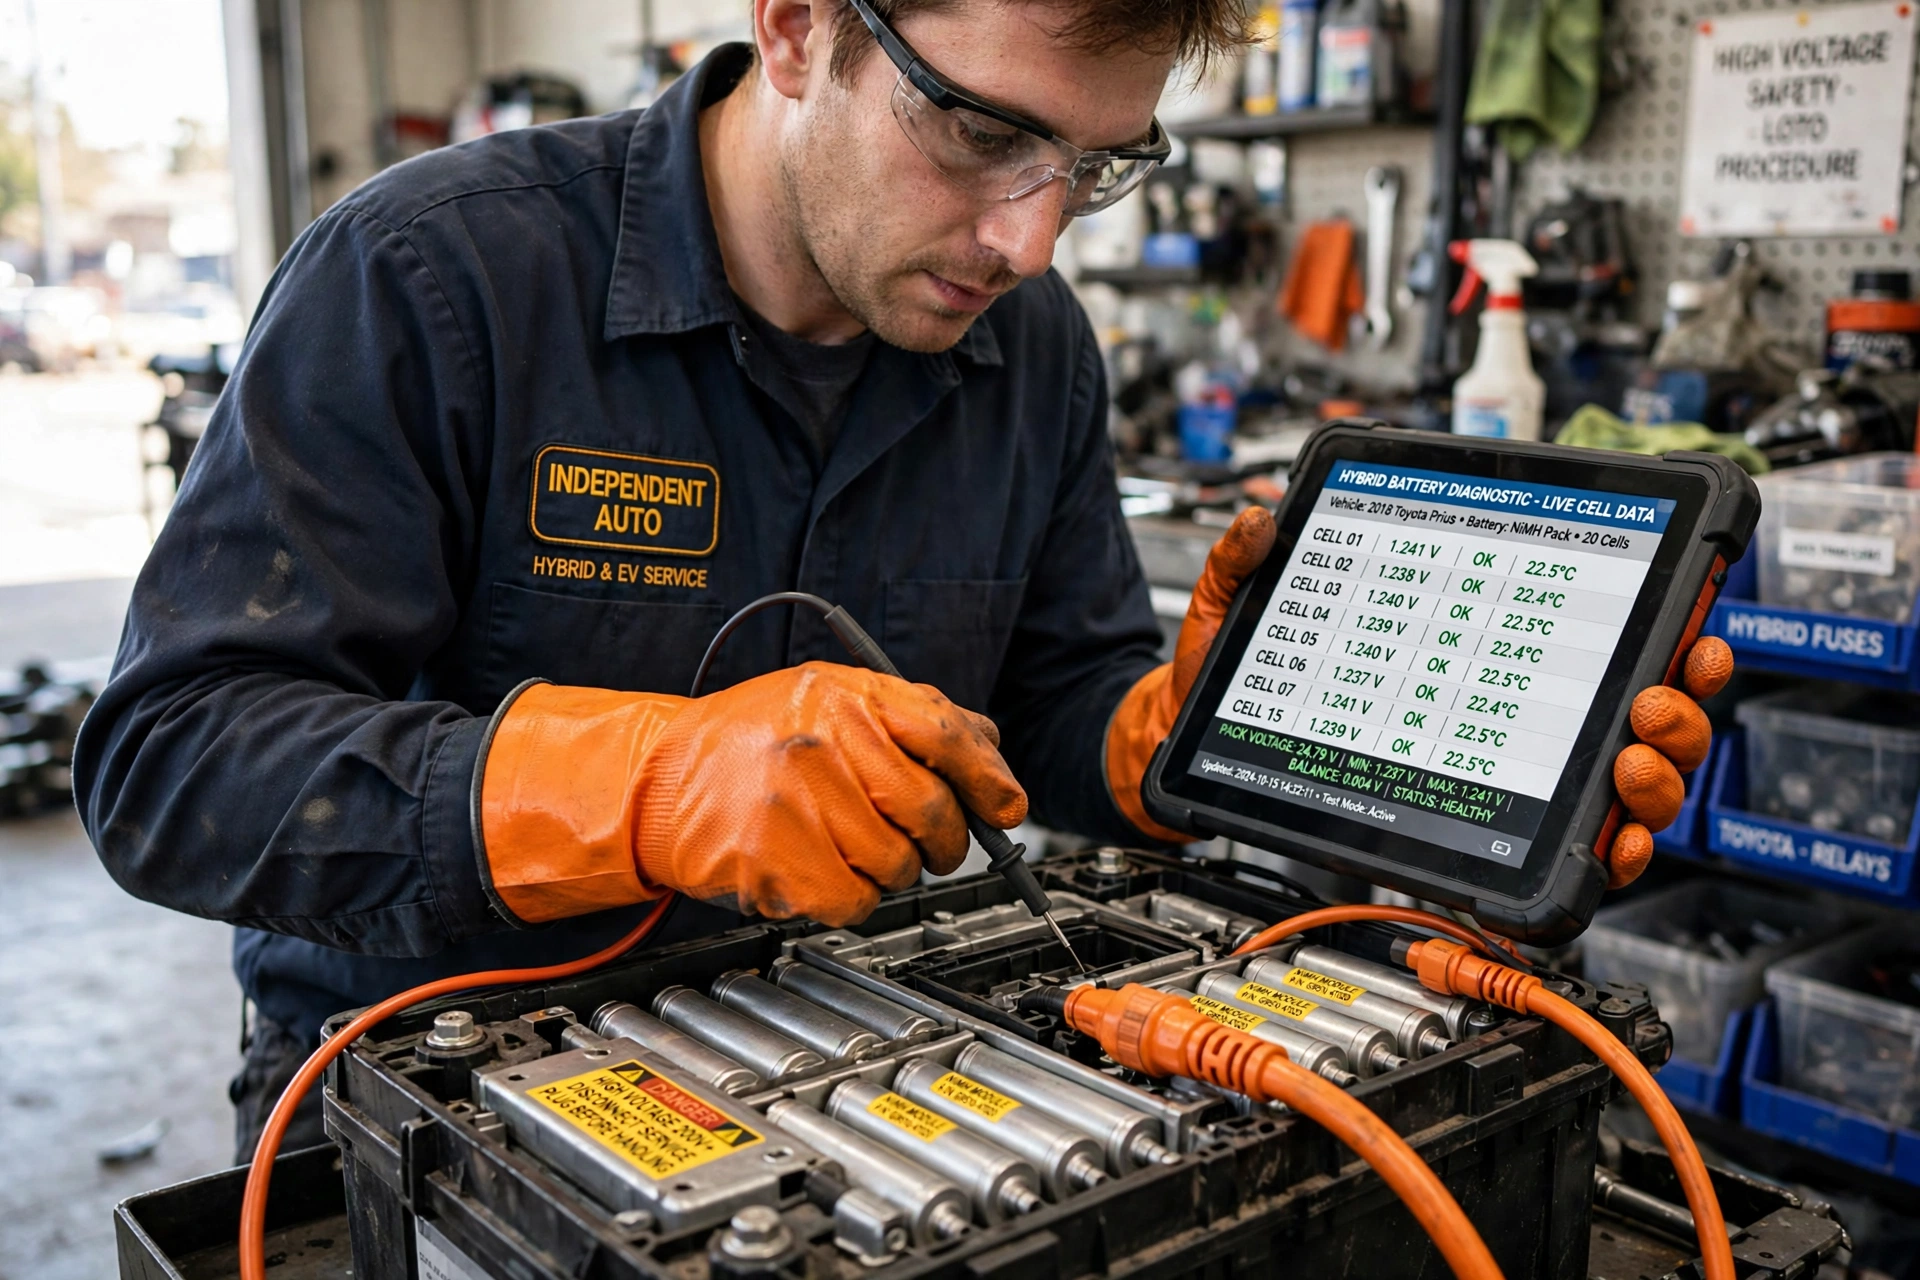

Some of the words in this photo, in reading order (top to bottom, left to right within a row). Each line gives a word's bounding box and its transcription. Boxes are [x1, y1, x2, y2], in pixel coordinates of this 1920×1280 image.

[1713, 42, 1773, 72] HIGH
[1779, 32, 1890, 70] VOLTAGE
[1748, 74, 1839, 108] SAFETY
[1762, 112, 1829, 145] LOTO
[1714, 149, 1861, 183] PROCEDURE
[549, 463, 707, 507] INDEPENDENT
[1338, 469, 1387, 488] HYBRID
[1387, 475, 1448, 495] BATTERY
[1447, 483, 1532, 506] DIAGNOSTIC
[1542, 495, 1576, 512] LIVE
[1576, 500, 1612, 517] CELL
[1615, 504, 1655, 523] DATA
[594, 504, 662, 536] AUTO
[1330, 496, 1367, 512] Vehicle:
[1367, 501, 1394, 515] 2018
[1395, 505, 1427, 521] Toyota
[1429, 510, 1456, 525] Prius
[1466, 516, 1507, 534] Battery:
[1510, 521, 1543, 538] NiMH
[1543, 525, 1572, 541] Pack
[1582, 531, 1599, 545] 20
[1600, 534, 1630, 549] Cells
[533, 556, 596, 580] HYBRID
[600, 562, 612, 581] &
[618, 564, 639, 583] EV
[643, 566, 708, 588] SERVICE
[1301, 551, 1330, 568] CELL
[1334, 557, 1353, 572] 02
[1378, 564, 1416, 583] 1.238
[1419, 570, 1430, 584] V
[1461, 578, 1485, 595] OK
[1513, 587, 1565, 608] 22.4°C
[1313, 527, 1342, 544] CELL
[1346, 532, 1363, 547] 01
[1390, 539, 1426, 557] 1.241
[1430, 545, 1442, 559] V
[1472, 551, 1497, 568] OK
[1525, 560, 1577, 581] 22.5°C
[1278, 600, 1308, 618] CELL
[1312, 606, 1331, 622] 04
[1356, 614, 1393, 633] 1.239
[1396, 621, 1408, 636] V
[1438, 630, 1462, 647] OK
[1490, 640, 1543, 663] 22.4°C
[1290, 575, 1320, 593] CELL
[1323, 581, 1342, 596] 03
[1367, 589, 1404, 608] 1.240
[1408, 595, 1419, 610] V
[1450, 604, 1474, 621] OK
[1502, 613, 1554, 636] 22.5°C
[1267, 624, 1296, 643] CELL
[1300, 631, 1319, 646] 05
[1344, 640, 1382, 660] 1.240
[1385, 649, 1396, 662] V
[1427, 657, 1451, 674] OK
[1478, 668, 1531, 691] 22.5°C
[1727, 611, 1808, 646] HYBRID
[1811, 623, 1884, 658] FUSES
[1244, 674, 1274, 693] CELL
[1277, 681, 1297, 697] 07
[1321, 692, 1357, 712] 1.241
[1361, 700, 1373, 715] V
[1403, 711, 1427, 729] OK
[1454, 723, 1507, 747] 22.5°C
[1255, 649, 1285, 668] CELL
[1289, 656, 1307, 672] 06
[1333, 666, 1372, 686] 1.237
[1374, 674, 1385, 689] V
[1415, 684, 1439, 702] OK
[1466, 695, 1519, 719] 22.4°C
[1218, 723, 1248, 741] PACK
[1249, 730, 1297, 753] VOLTAGE:
[1296, 743, 1327, 760] 24.79
[1329, 750, 1339, 763] V
[1347, 755, 1373, 773] MIN:
[1374, 763, 1406, 781] 1.237
[1407, 770, 1417, 783] V
[1426, 776, 1458, 795] MAX:
[1461, 785, 1492, 804] 1.241
[1495, 793, 1506, 806] V
[1232, 699, 1262, 718] CELL
[1267, 707, 1284, 723] 15
[1309, 717, 1347, 738] 1.239
[1350, 727, 1362, 741] V
[1391, 738, 1415, 756] OK
[1443, 751, 1495, 776] 22.5°C
[1288, 758, 1341, 782] BALANCE:
[1342, 773, 1372, 790] 0.004
[1374, 780, 1383, 792] V
[1392, 785, 1439, 808] STATUS:
[1439, 798, 1496, 823] HEALTHY
[1322, 792, 1340, 806] Test
[1366, 806, 1396, 822] Active
[1718, 818, 1796, 861] TOYOTA
[1810, 840, 1891, 882] RELAYS
[566, 1082, 646, 1128] DISCONNECT
[638, 1127, 697, 1162] SERVICE
[593, 1076, 630, 1097] HIGH
[623, 1091, 681, 1127] VOLTAGE
[646, 1083, 719, 1126] DANGER
[538, 1087, 576, 1108] PLUG
[569, 1105, 618, 1136] BEFORE
[609, 1131, 674, 1172] HANDLING
